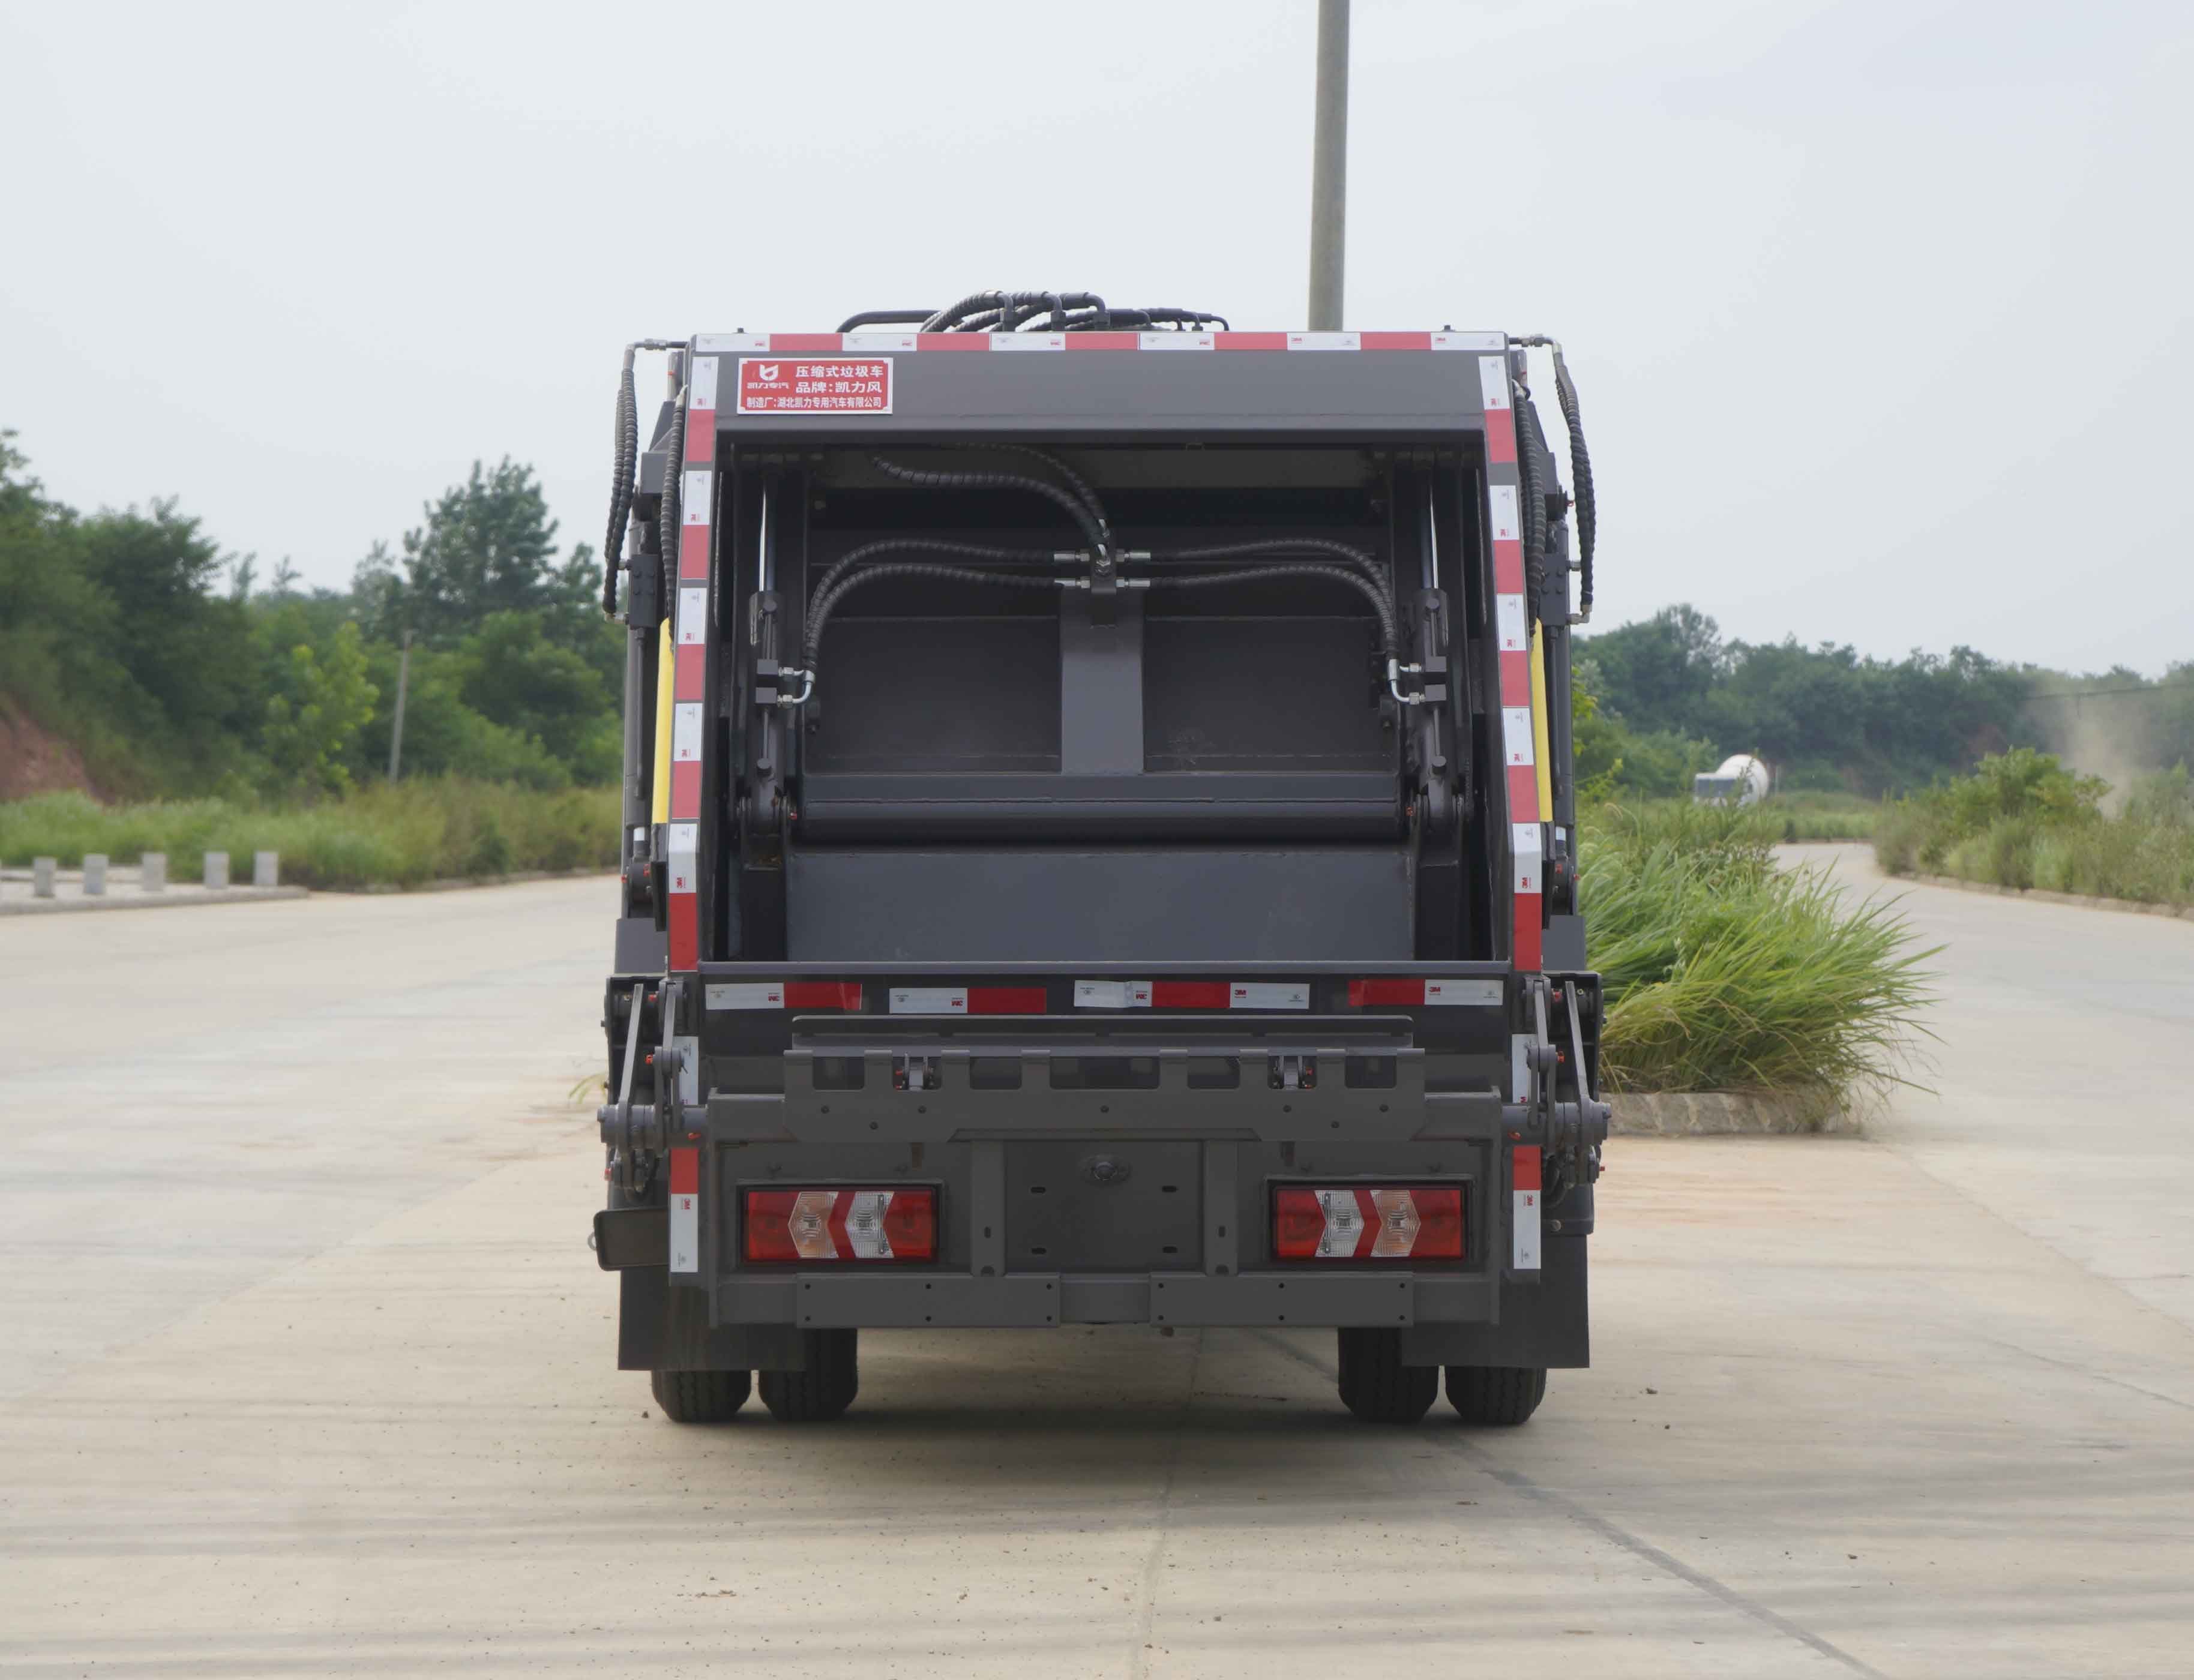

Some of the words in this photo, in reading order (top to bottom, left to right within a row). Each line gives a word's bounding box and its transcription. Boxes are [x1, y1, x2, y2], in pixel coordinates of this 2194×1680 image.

[796, 365, 883, 378] 压缩式垃圾车
